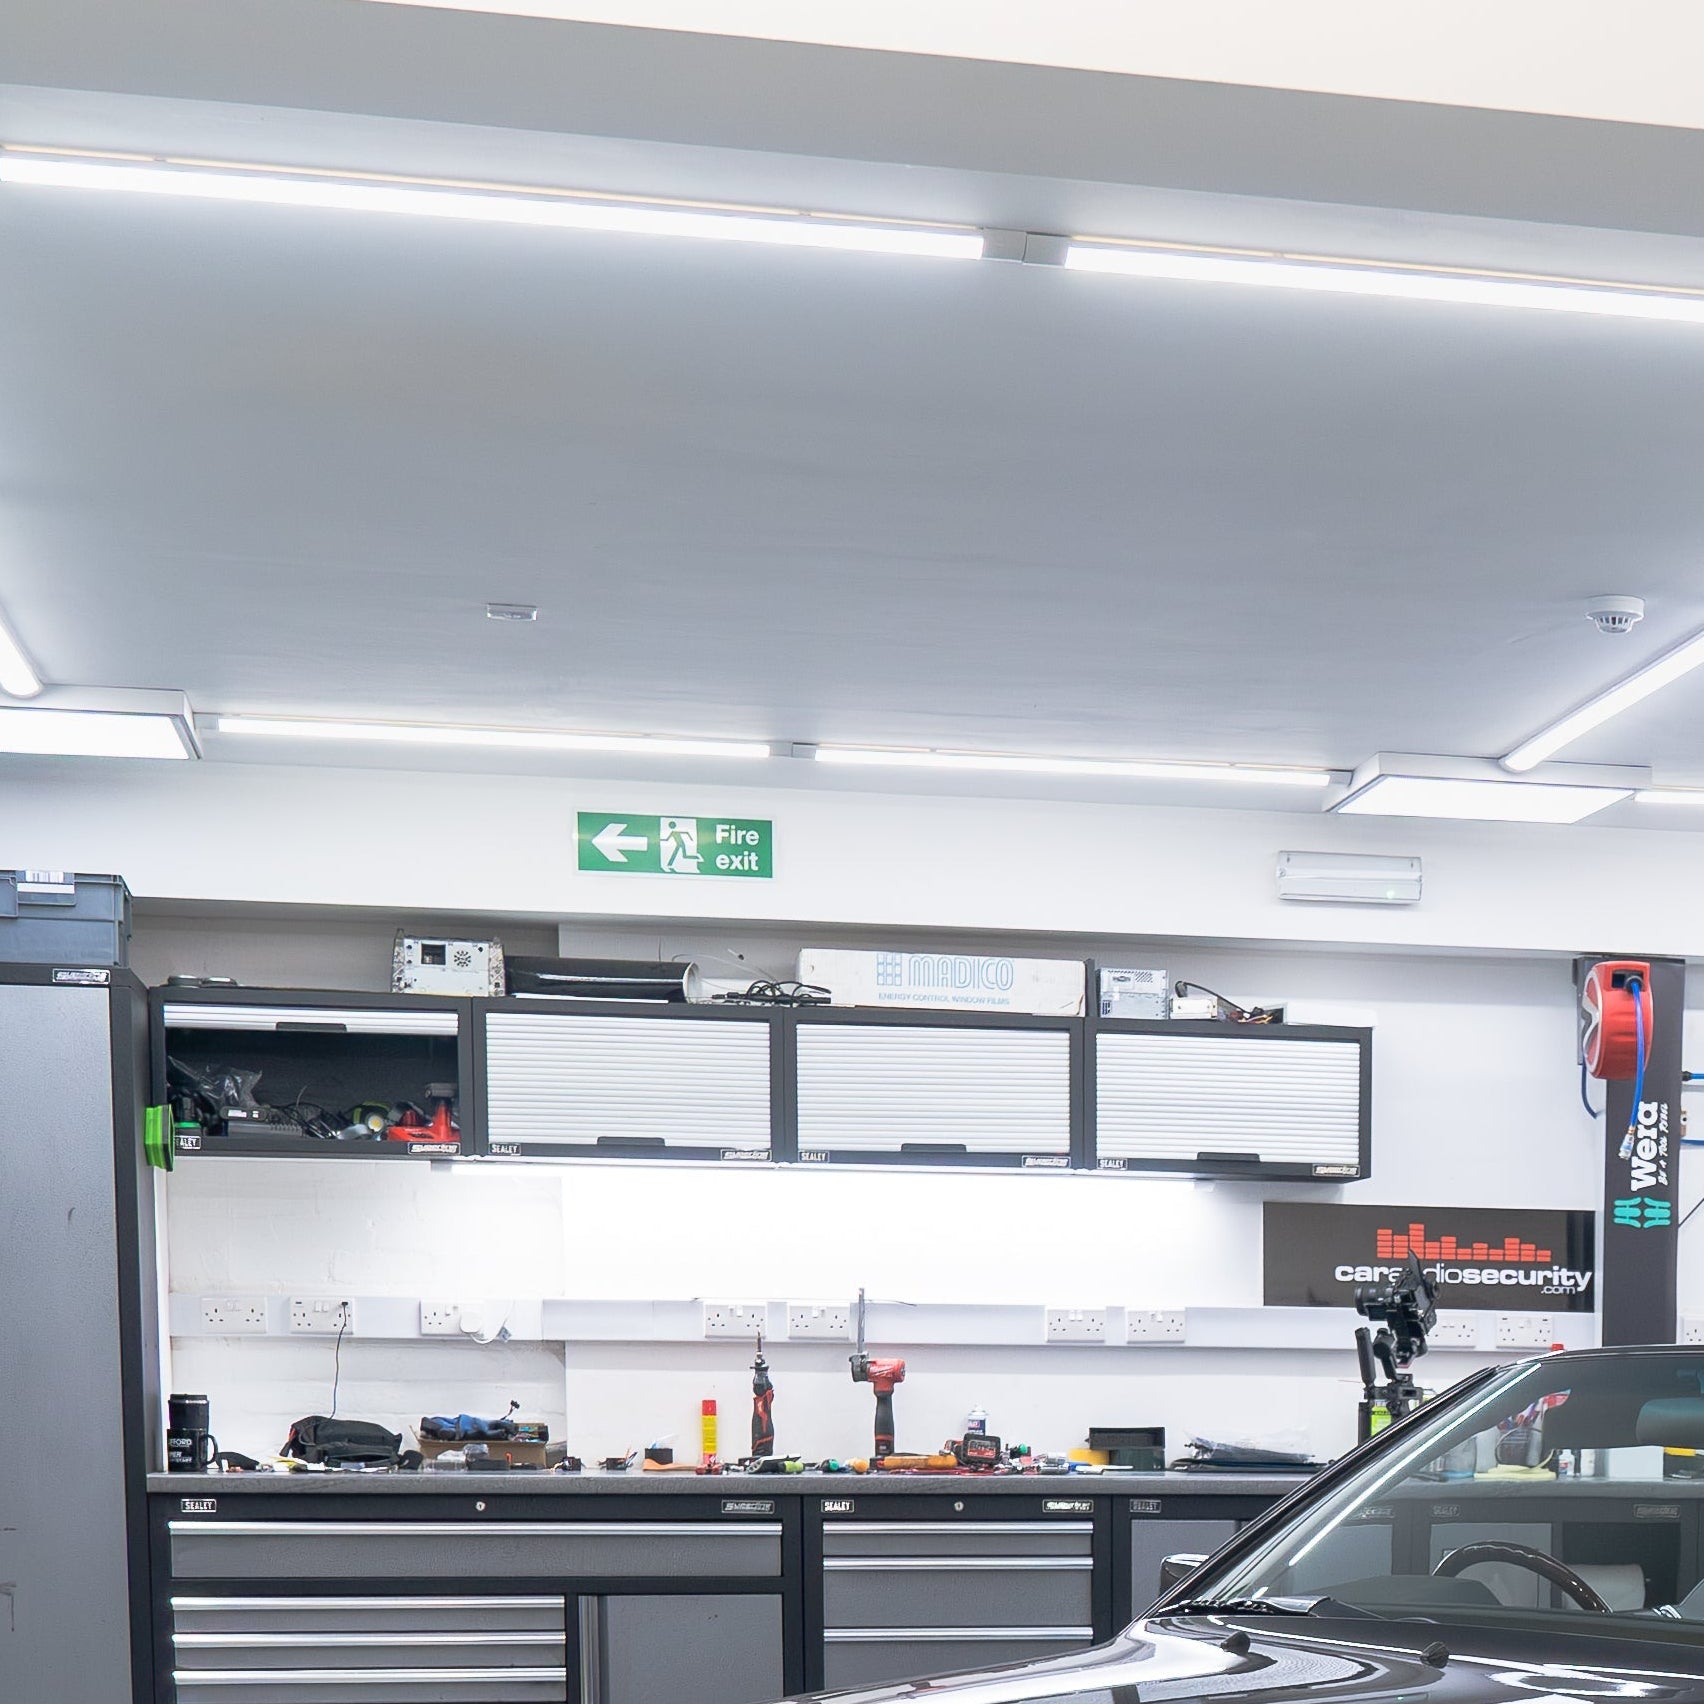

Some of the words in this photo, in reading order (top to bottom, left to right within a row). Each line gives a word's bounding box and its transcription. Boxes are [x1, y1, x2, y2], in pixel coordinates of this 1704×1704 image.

[716, 824, 760, 846] Fire
[715, 851, 759, 871] exit
[908, 955, 1014, 991] MADICO
[491, 1143, 518, 1154] SEALEY
[1630, 1101, 1659, 1192] Wera
[801, 1151, 827, 1161] SEALEY
[1334, 1263, 1593, 1292] caradiosecurity
[1540, 1284, 1576, 1295] .com
[185, 1501, 212, 1510] SEALEY
[824, 1501, 850, 1511] SEALEY
